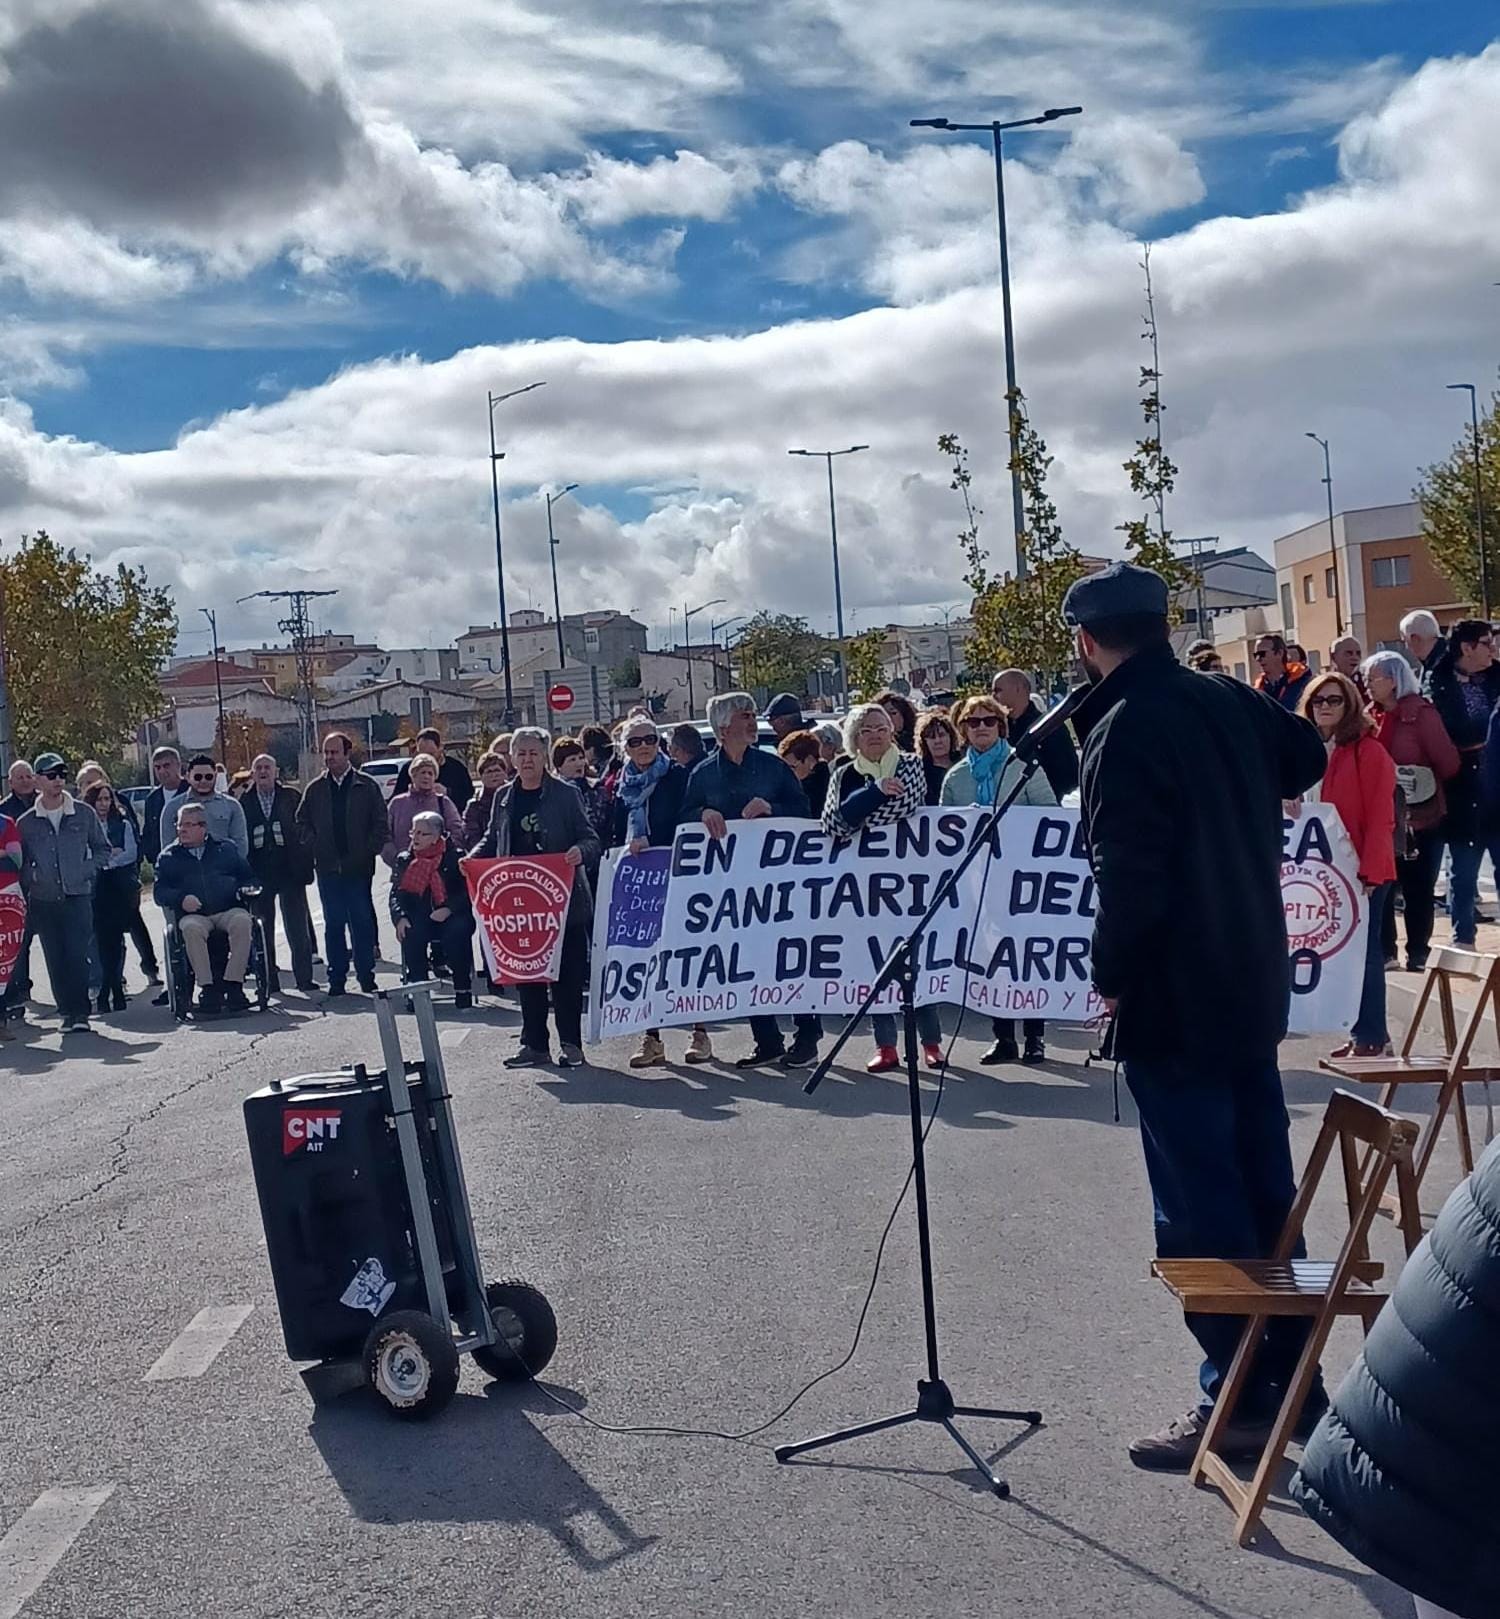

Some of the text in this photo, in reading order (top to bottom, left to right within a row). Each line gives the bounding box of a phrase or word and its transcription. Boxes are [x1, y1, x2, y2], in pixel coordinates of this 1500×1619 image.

[671, 832, 737, 877] EN
[760, 812, 1001, 868] DEFENSA
[513, 897, 525, 907] EL
[525, 869, 565, 904] CALIDAD
[685, 868, 1096, 933] SANITARIA DEL
[518, 938, 531, 948] DE
[776, 935, 843, 982] DE
[929, 974, 951, 995] DE
[1062, 991, 1077, 1011] Y
[287, 1117, 341, 1139] CNT
[306, 1142, 324, 1152] AIT
